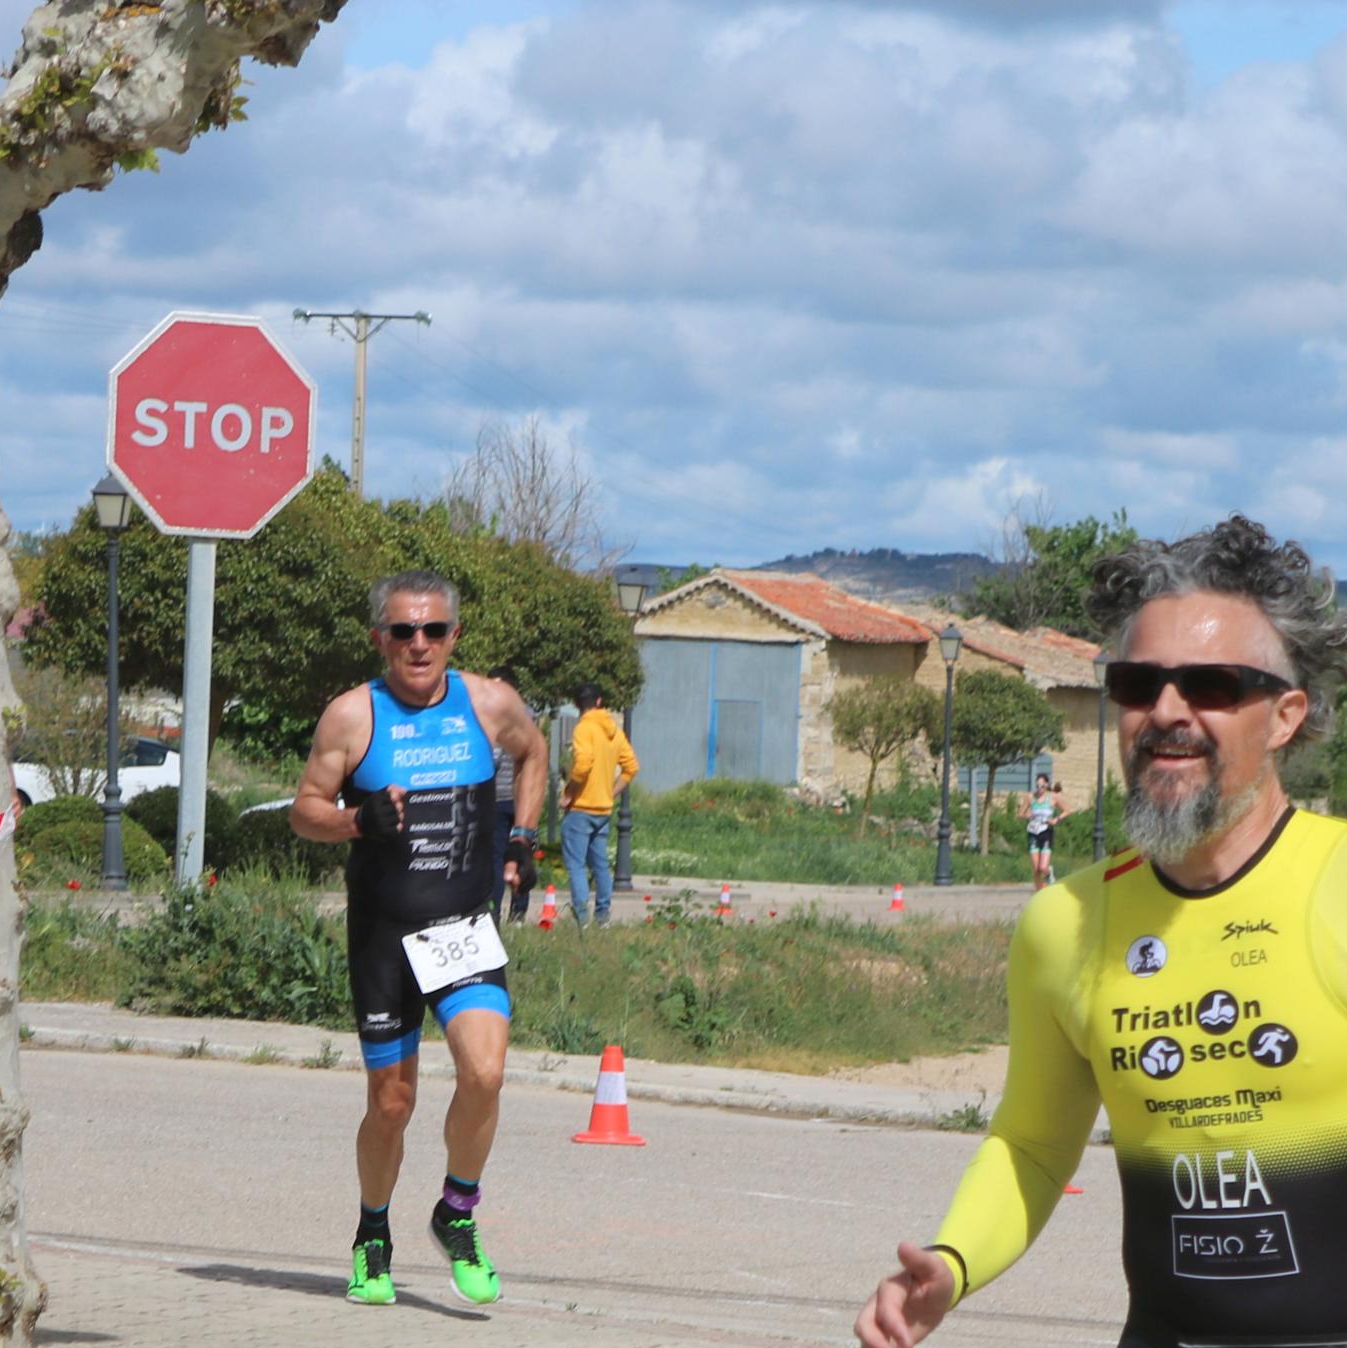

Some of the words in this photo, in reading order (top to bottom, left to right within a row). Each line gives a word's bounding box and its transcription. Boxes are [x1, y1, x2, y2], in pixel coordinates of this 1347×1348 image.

[131, 398, 294, 454] STOP
[393, 742, 473, 768] RODRIGUEZ
[1222, 919, 1278, 940] Spiuk
[432, 935, 480, 968] 385
[1231, 950, 1267, 967] OLEA
[1145, 1095, 1232, 1116] Desguaces
[1236, 1087, 1282, 1107] Maxi
[1172, 1150, 1272, 1210] OLEA
[1179, 1235, 1245, 1255] FISIO
